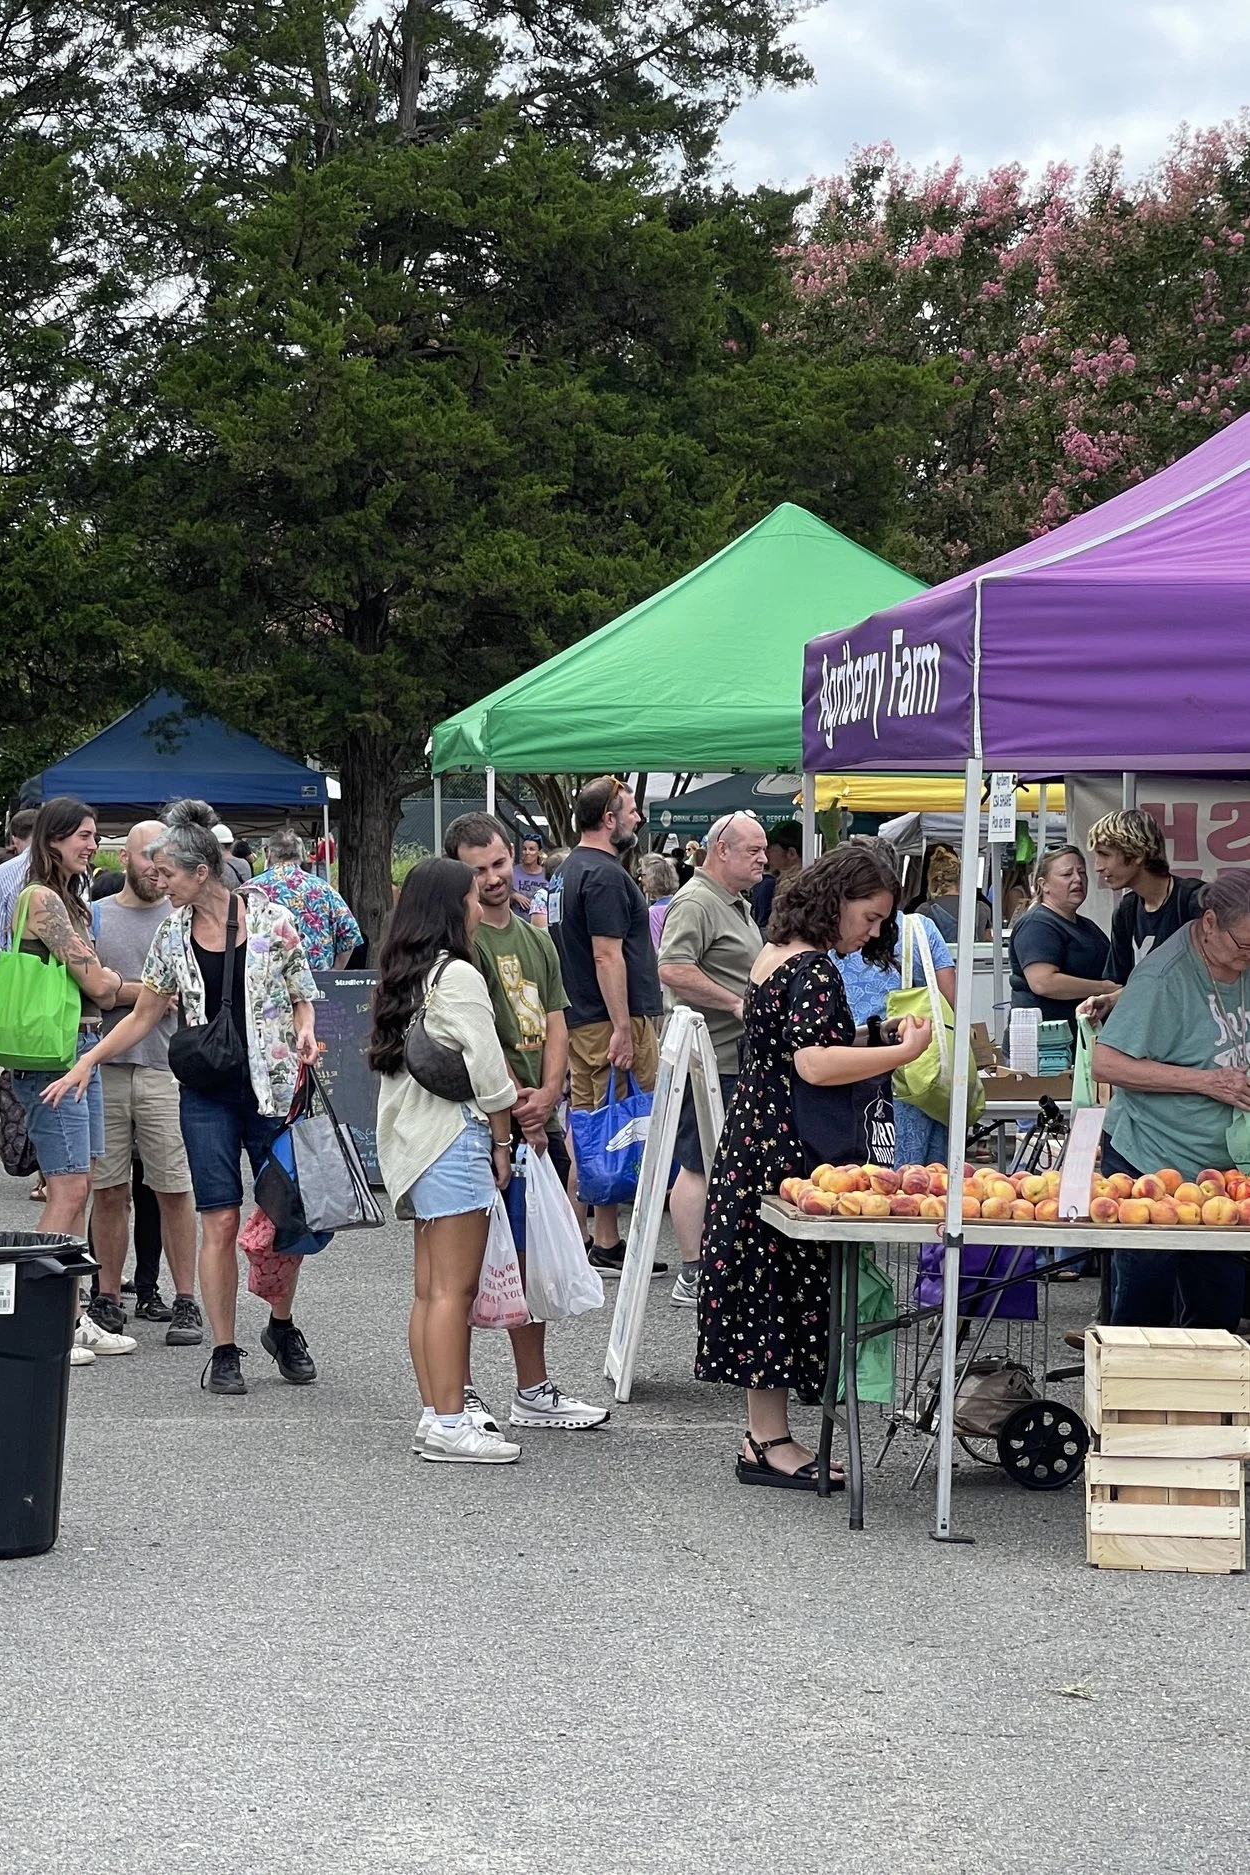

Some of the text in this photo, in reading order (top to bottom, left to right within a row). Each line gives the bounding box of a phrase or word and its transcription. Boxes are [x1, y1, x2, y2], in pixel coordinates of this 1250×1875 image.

[817, 628, 941, 750] Agriberry Farm
[672, 815, 691, 823] DRINK
[871, 1120, 896, 1147] BIRD
[872, 1146, 895, 1165] HOUS
